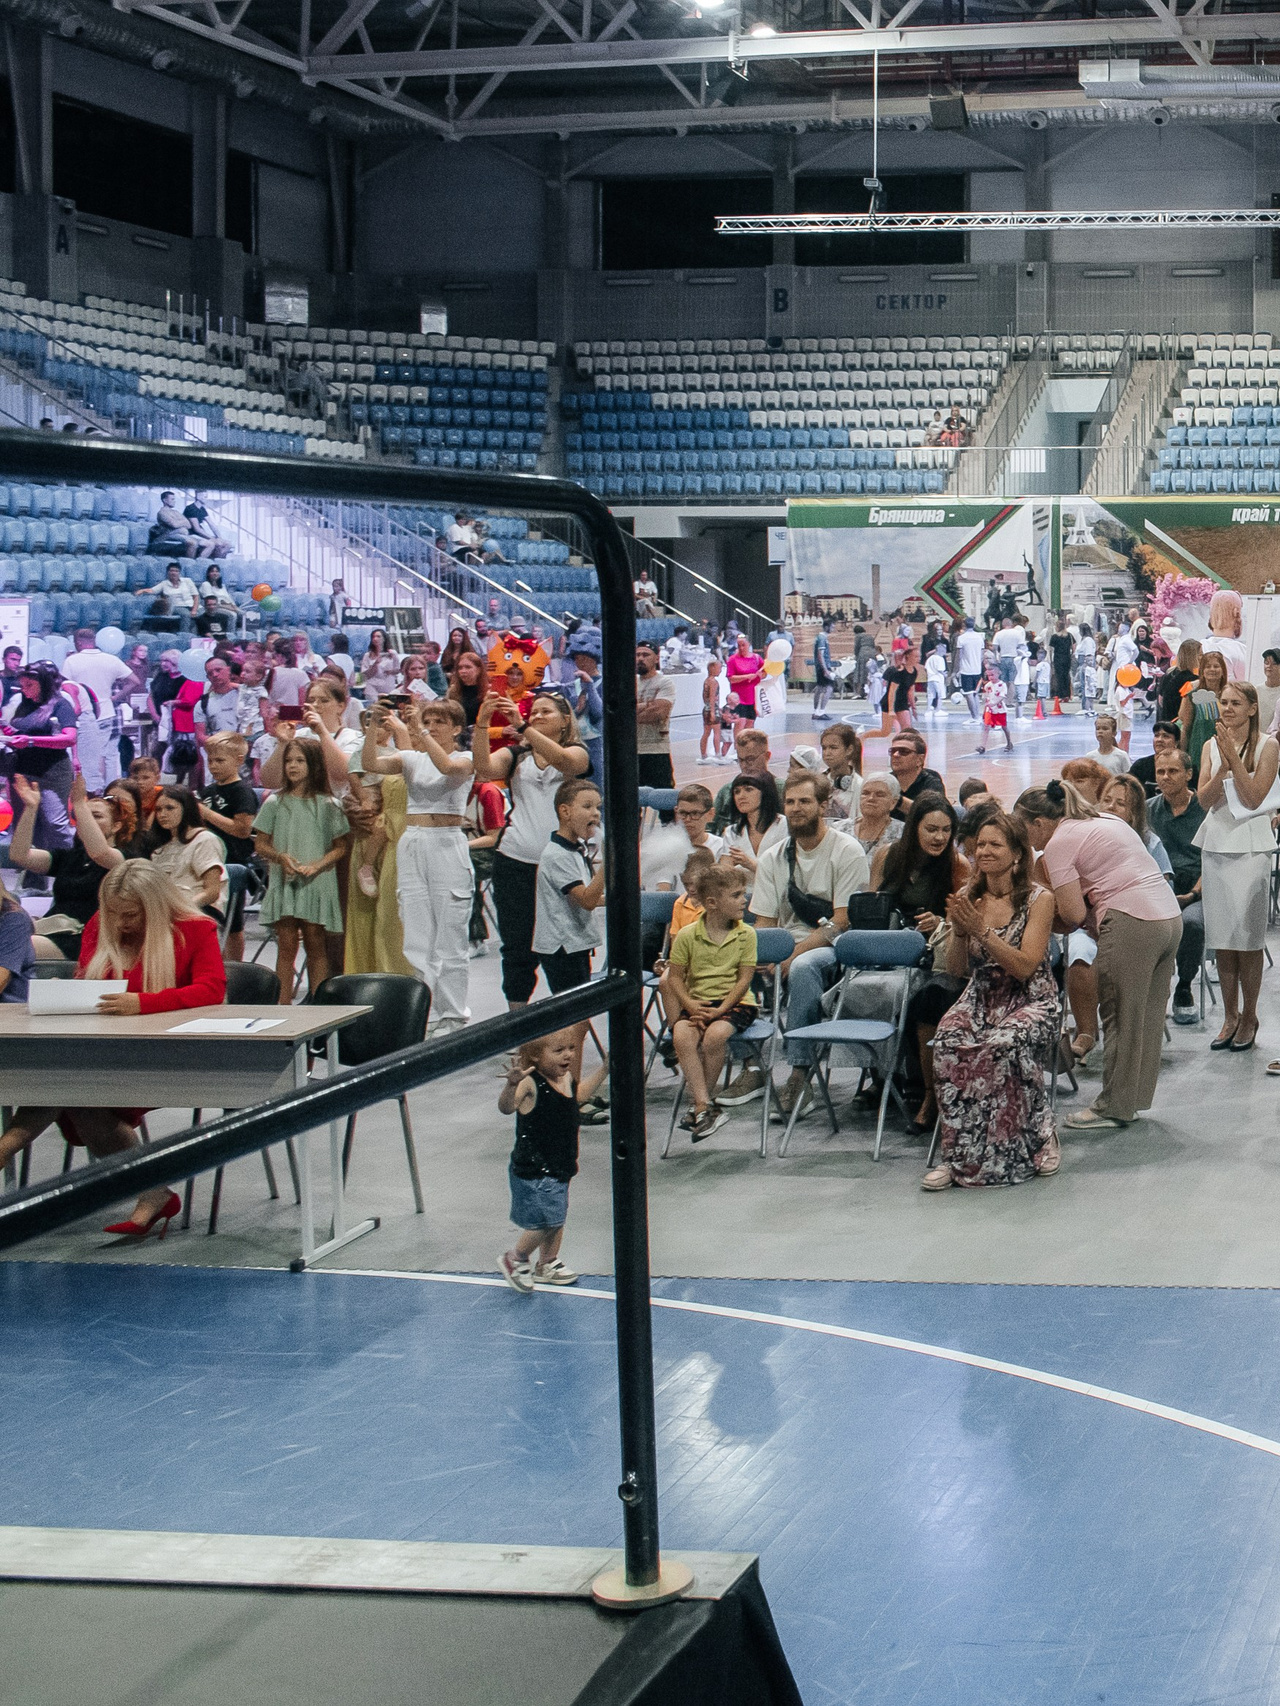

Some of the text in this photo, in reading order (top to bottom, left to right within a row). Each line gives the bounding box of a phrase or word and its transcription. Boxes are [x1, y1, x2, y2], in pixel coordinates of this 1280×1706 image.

[876, 294, 947, 310] СЕКТОР
[868, 507, 946, 525] Брянщина
[1231, 504, 1270, 524] край
